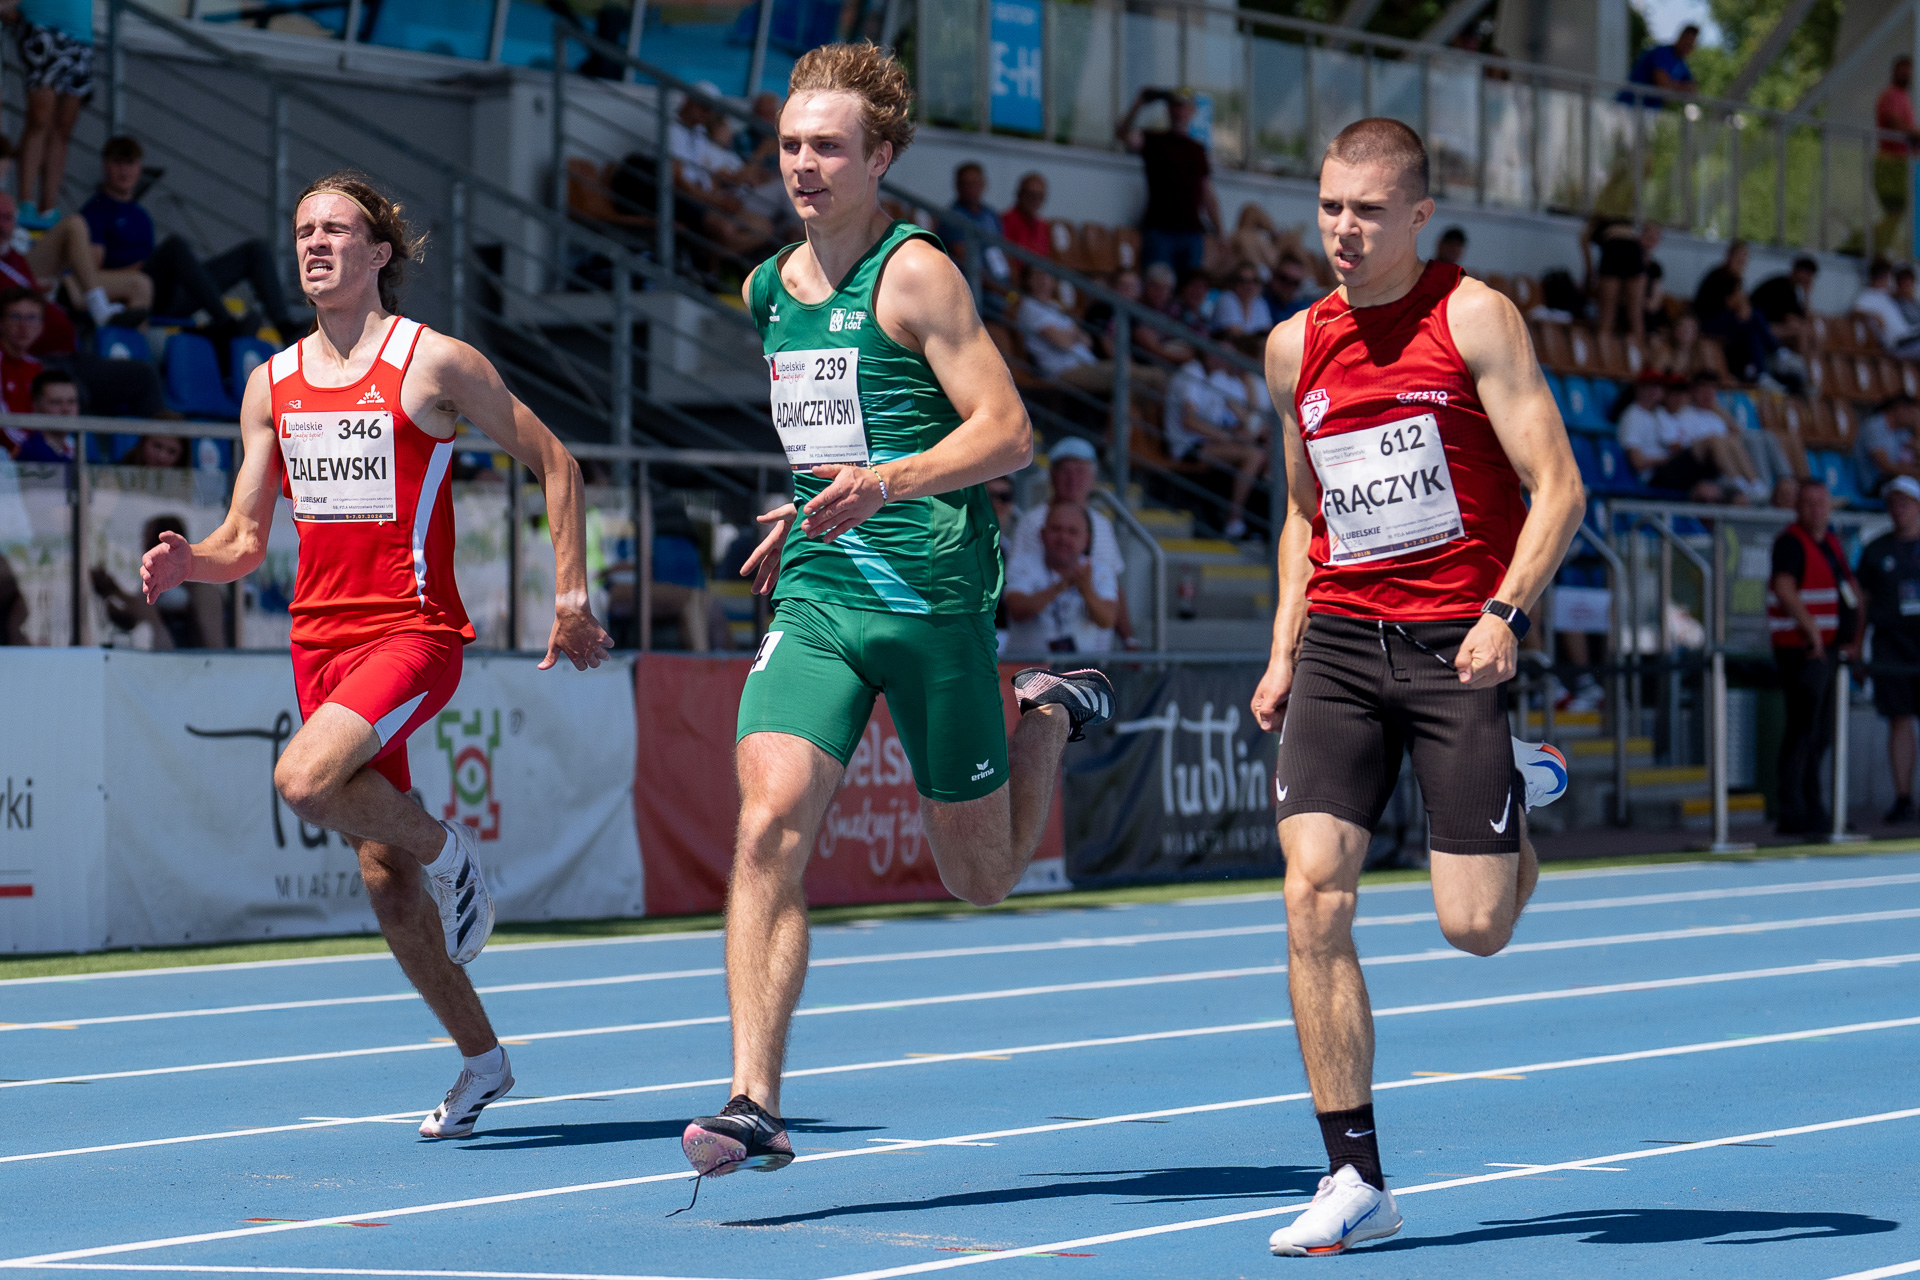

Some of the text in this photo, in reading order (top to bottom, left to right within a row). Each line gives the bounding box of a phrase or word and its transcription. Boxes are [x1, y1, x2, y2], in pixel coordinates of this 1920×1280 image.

[814, 356, 848, 381] 239
[776, 399, 856, 428] ADAMCZEWSKI
[337, 418, 382, 440] 346
[1380, 424, 1426, 457] 612
[289, 456, 387, 481] ZALEWSKI
[1324, 464, 1447, 517] FRĄCZYK
[1341, 526, 1382, 540] LUBELSKIE
[971, 767, 995, 781] erima
